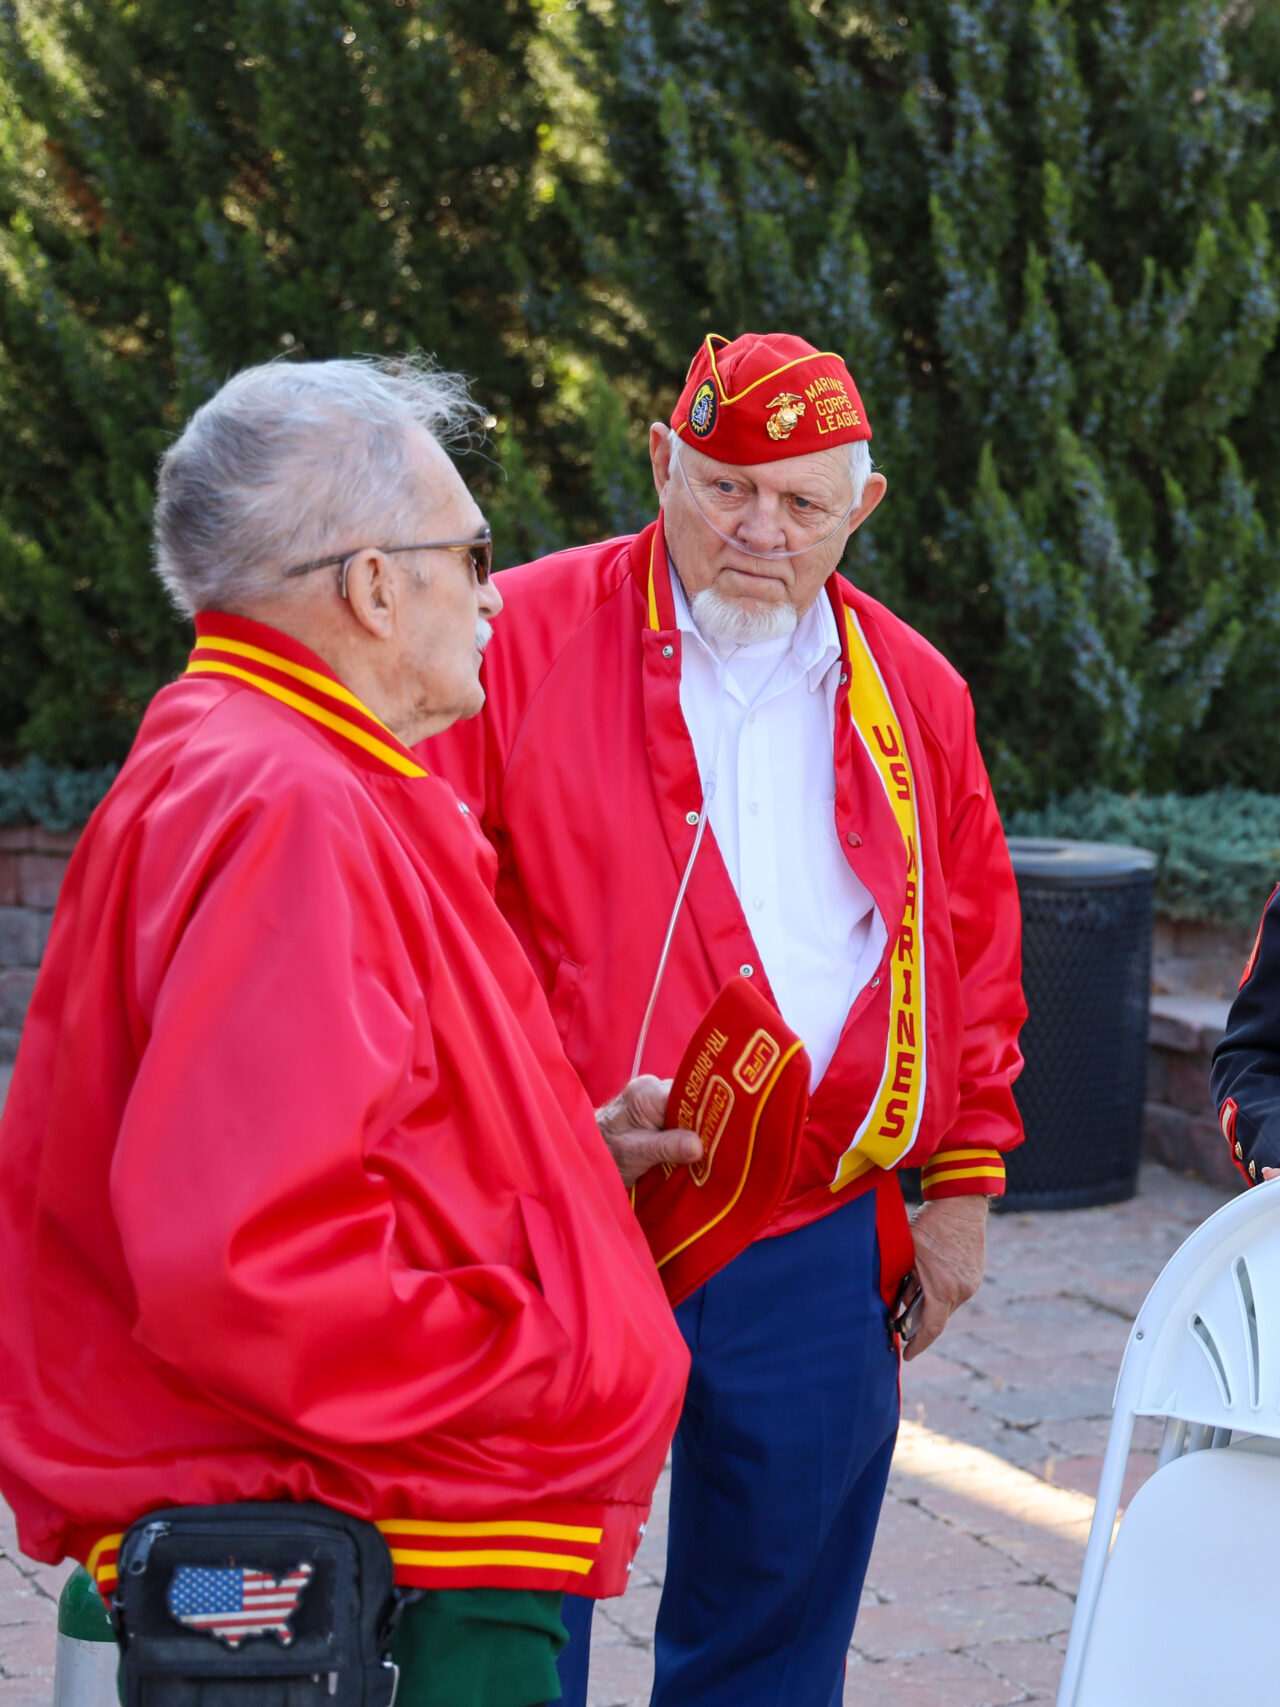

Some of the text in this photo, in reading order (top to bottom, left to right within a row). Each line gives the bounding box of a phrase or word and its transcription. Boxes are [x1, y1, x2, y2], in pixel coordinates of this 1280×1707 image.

[804, 377, 848, 403] MARINE
[815, 395, 853, 416] CORPS
[816, 410, 861, 435] LEAGUE
[685, 1027, 728, 1103] TRI-RIVERS
[743, 1042, 772, 1083] LIFE
